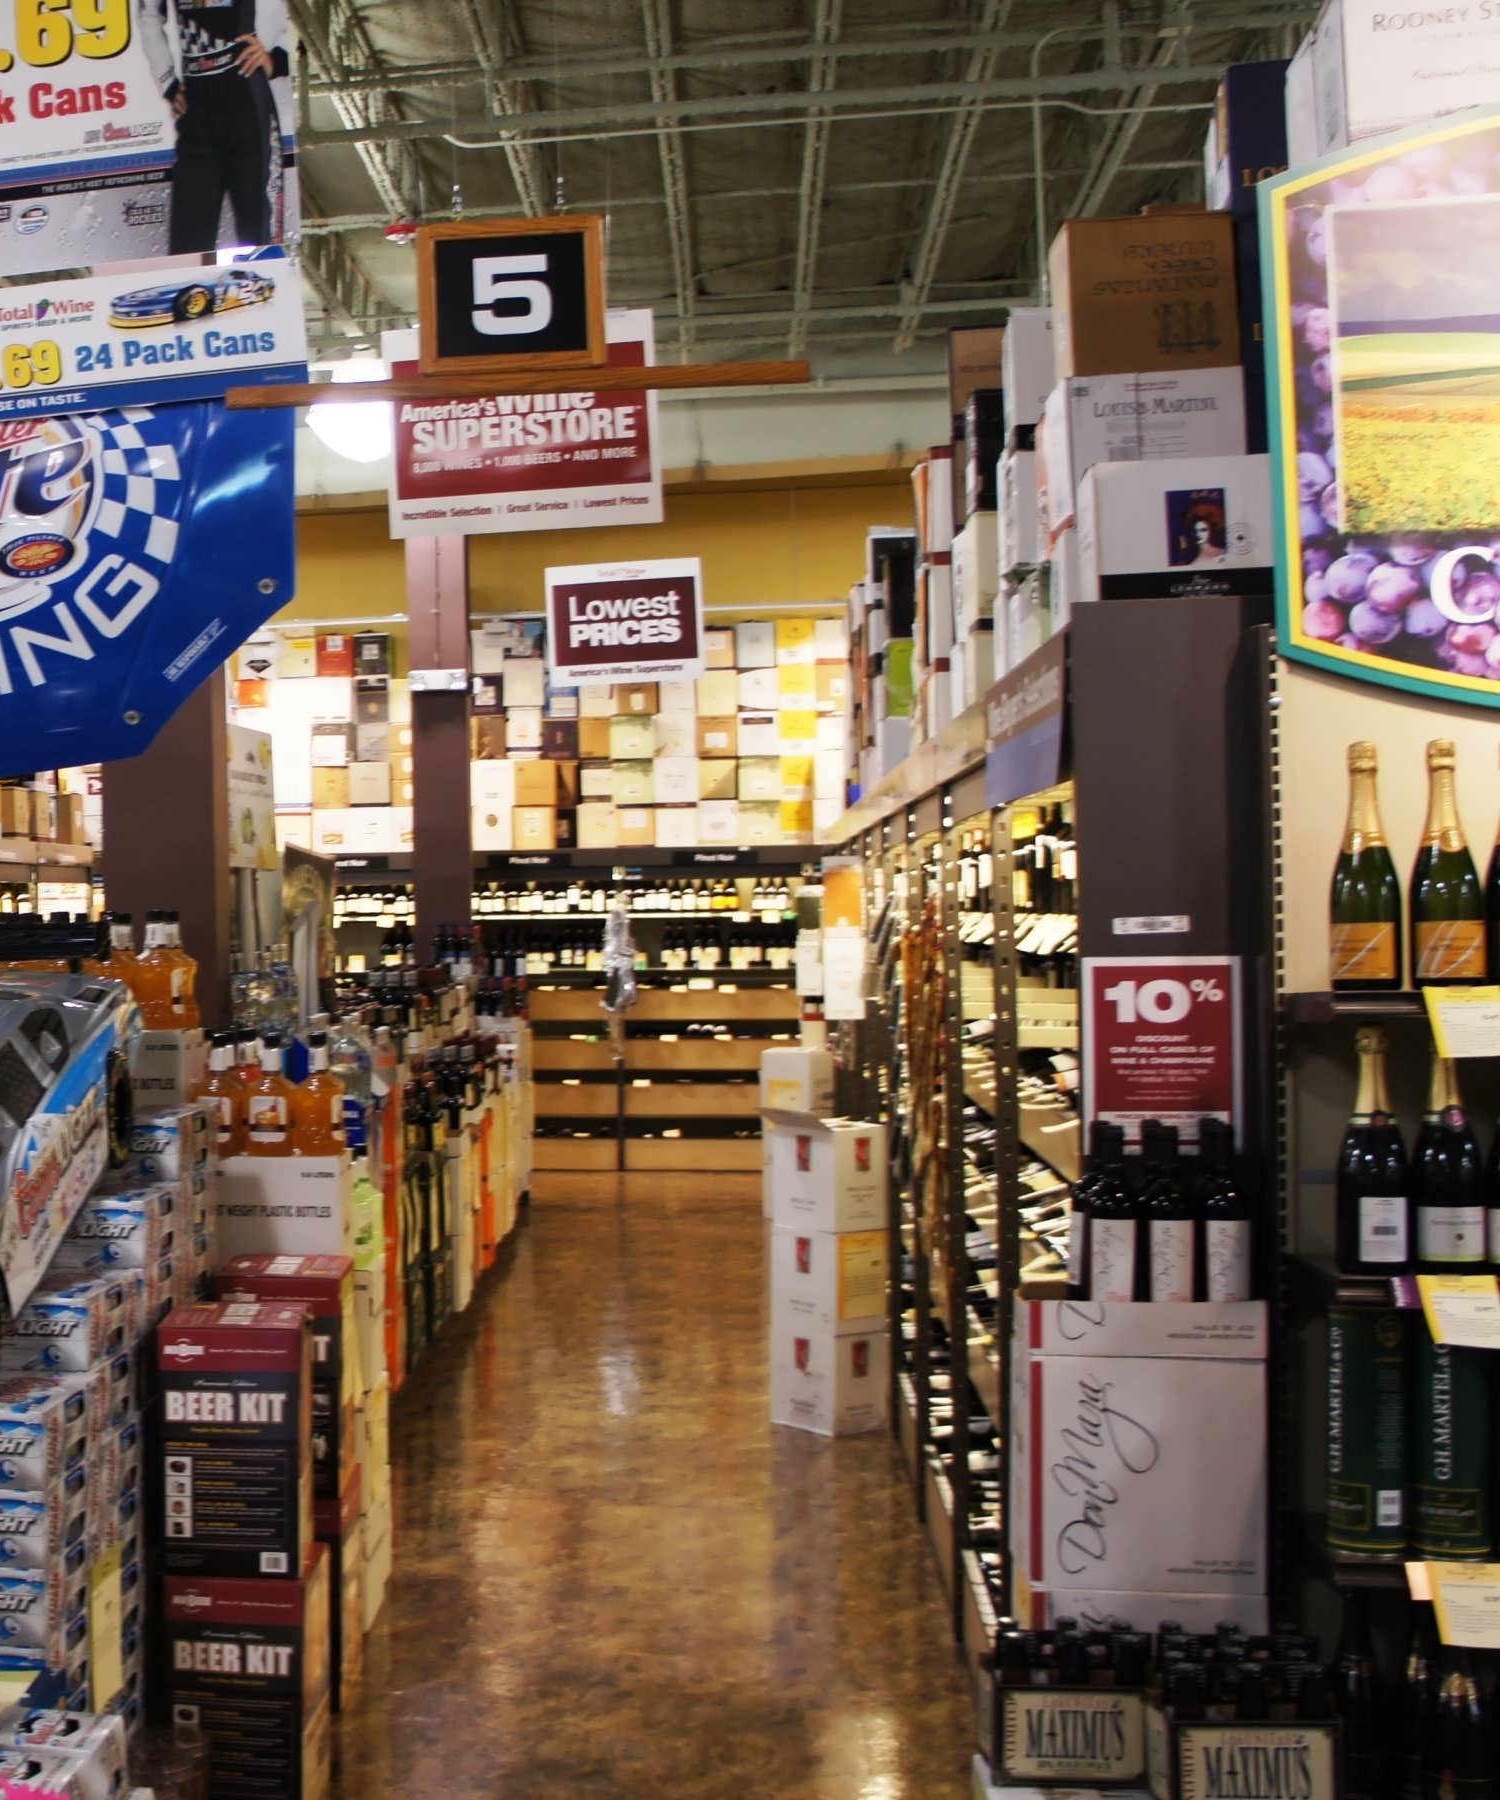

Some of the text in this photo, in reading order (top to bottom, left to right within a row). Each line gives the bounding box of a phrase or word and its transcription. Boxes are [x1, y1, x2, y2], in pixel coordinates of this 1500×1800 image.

[1371, 7, 1469, 33] RODNEY
[28, 80, 128, 120] Cans
[52, 299, 95, 315] Wine
[470, 254, 553, 336] 5
[75, 330, 276, 373] 24 Pack Cans
[17, 399, 39, 412] ON
[40, 392, 88, 409] TASTE.
[401, 398, 497, 424] America's
[412, 405, 637, 455] SUPERSTORE
[522, 451, 562, 466] BEERS
[572, 448, 600, 462] AND
[602, 445, 638, 459] MORE
[402, 495, 650, 521] Incredible Selection Great Service Lowest Prices
[567, 589, 682, 623] Lowest
[568, 617, 683, 649] PRICES
[568, 669, 609, 678] America's
[610, 666, 634, 676] Wine
[1102, 977, 1225, 1024] 10%
[260, 1204, 294, 1218] PLASTIC
[295, 1206, 333, 1218] BOTTLES
[17, 1317, 79, 1338] LIGHT
[164, 1390, 288, 1424] BEER KIT
[173, 1638, 293, 1676] BEER KIT
[1025, 1708, 1126, 1761] MAXIMUS
[1203, 1743, 1313, 1800] MAXIMUS
